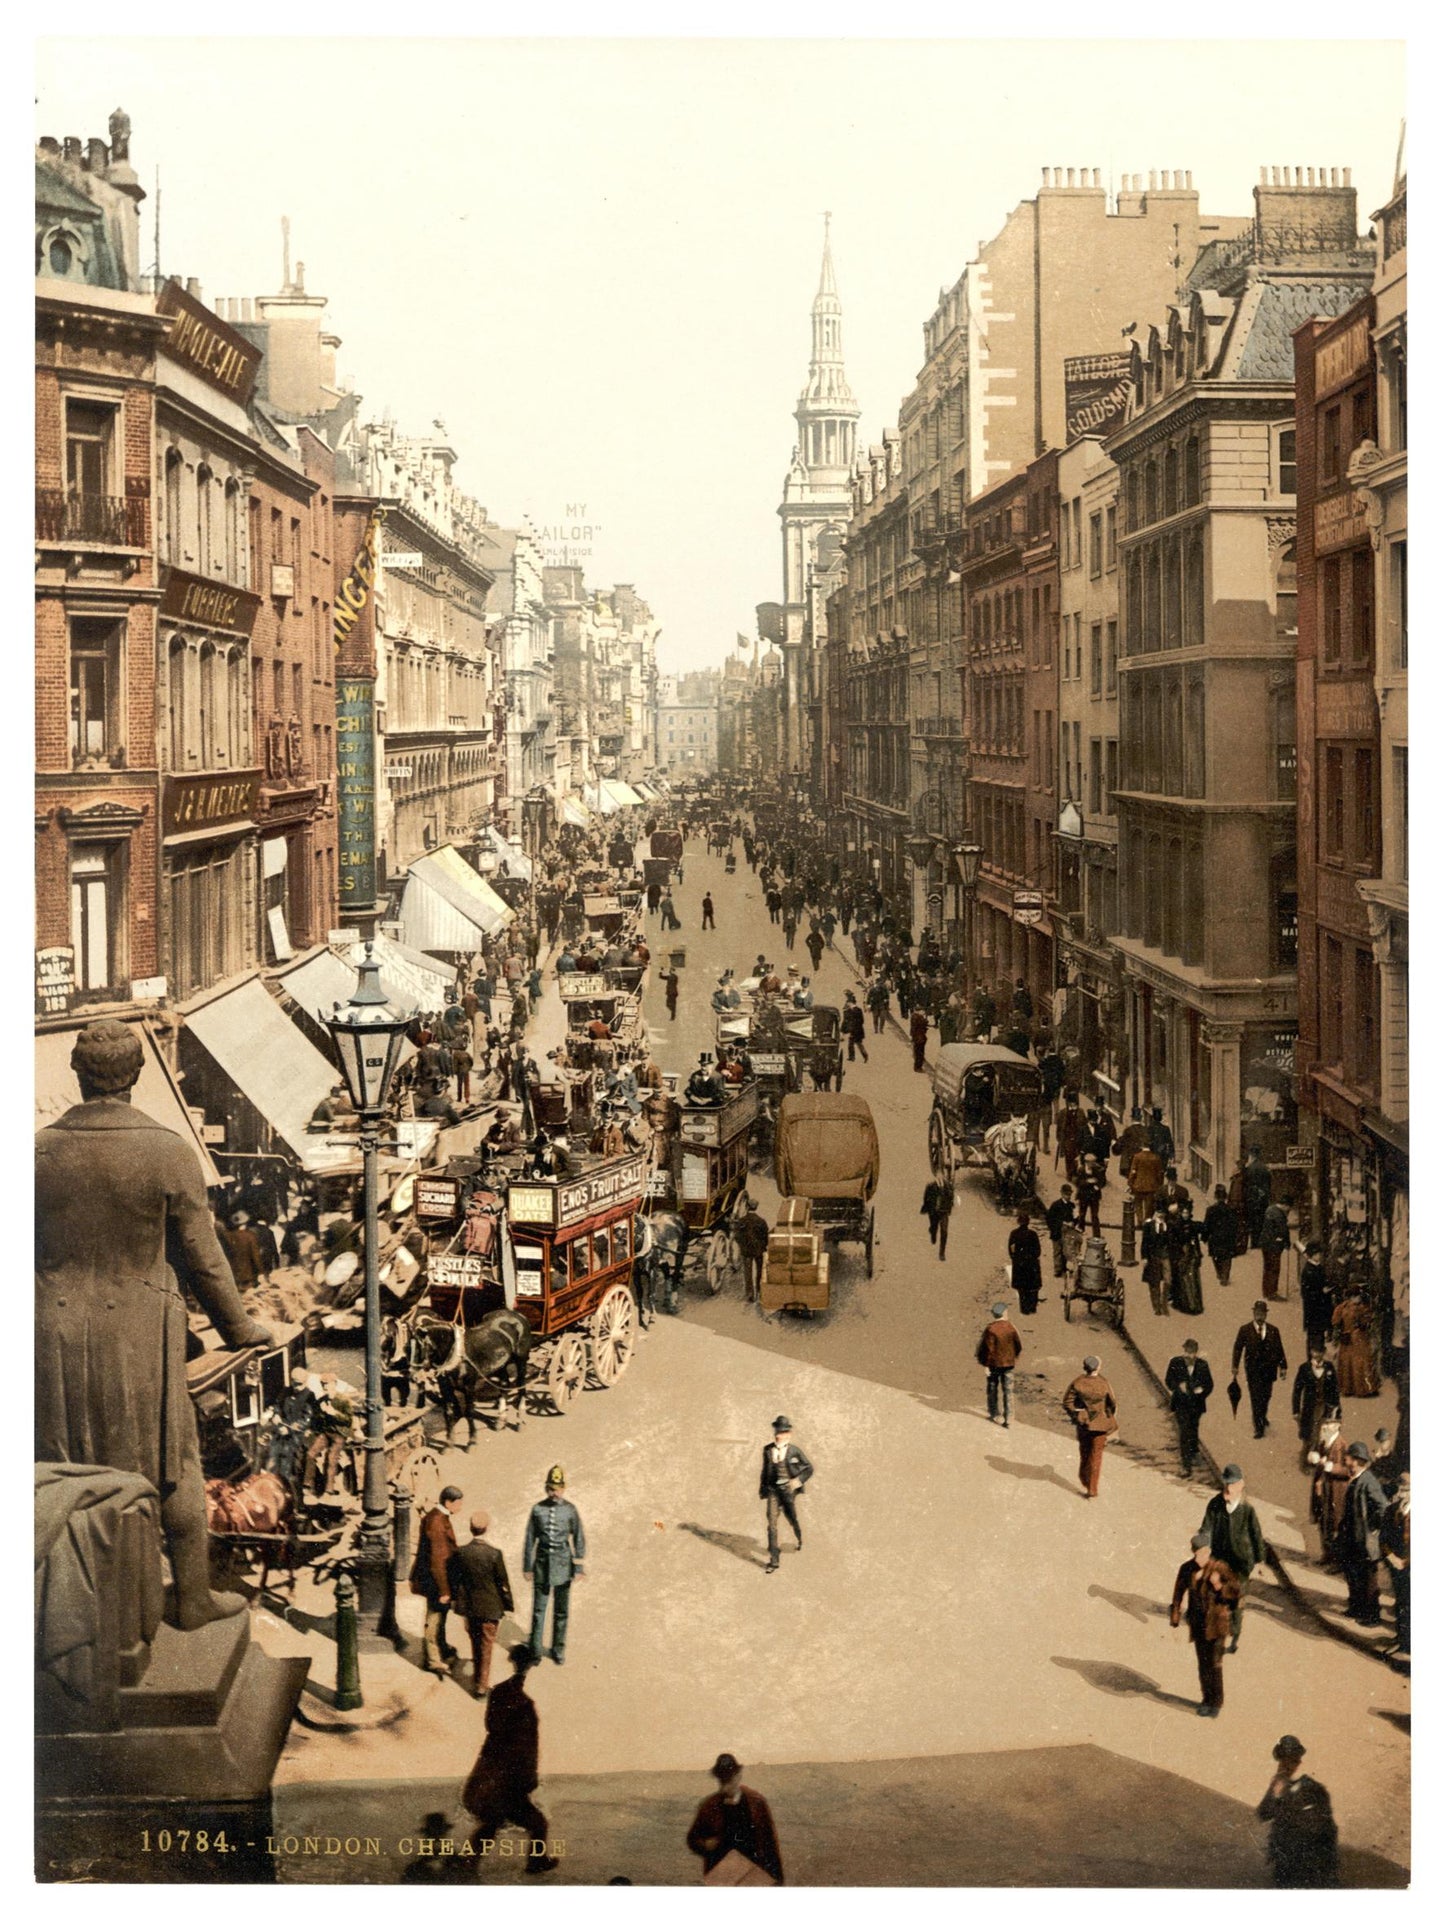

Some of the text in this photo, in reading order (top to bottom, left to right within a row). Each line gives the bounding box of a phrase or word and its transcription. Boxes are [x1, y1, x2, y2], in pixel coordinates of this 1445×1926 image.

[566, 503, 587, 517] MY
[181, 582, 239, 625] FURRIERS
[590, 1174, 620, 1201] FRUIT
[620, 1164, 643, 1189] SALT
[511, 1194, 552, 1211] QUAKER
[514, 1210, 549, 1221] OATS
